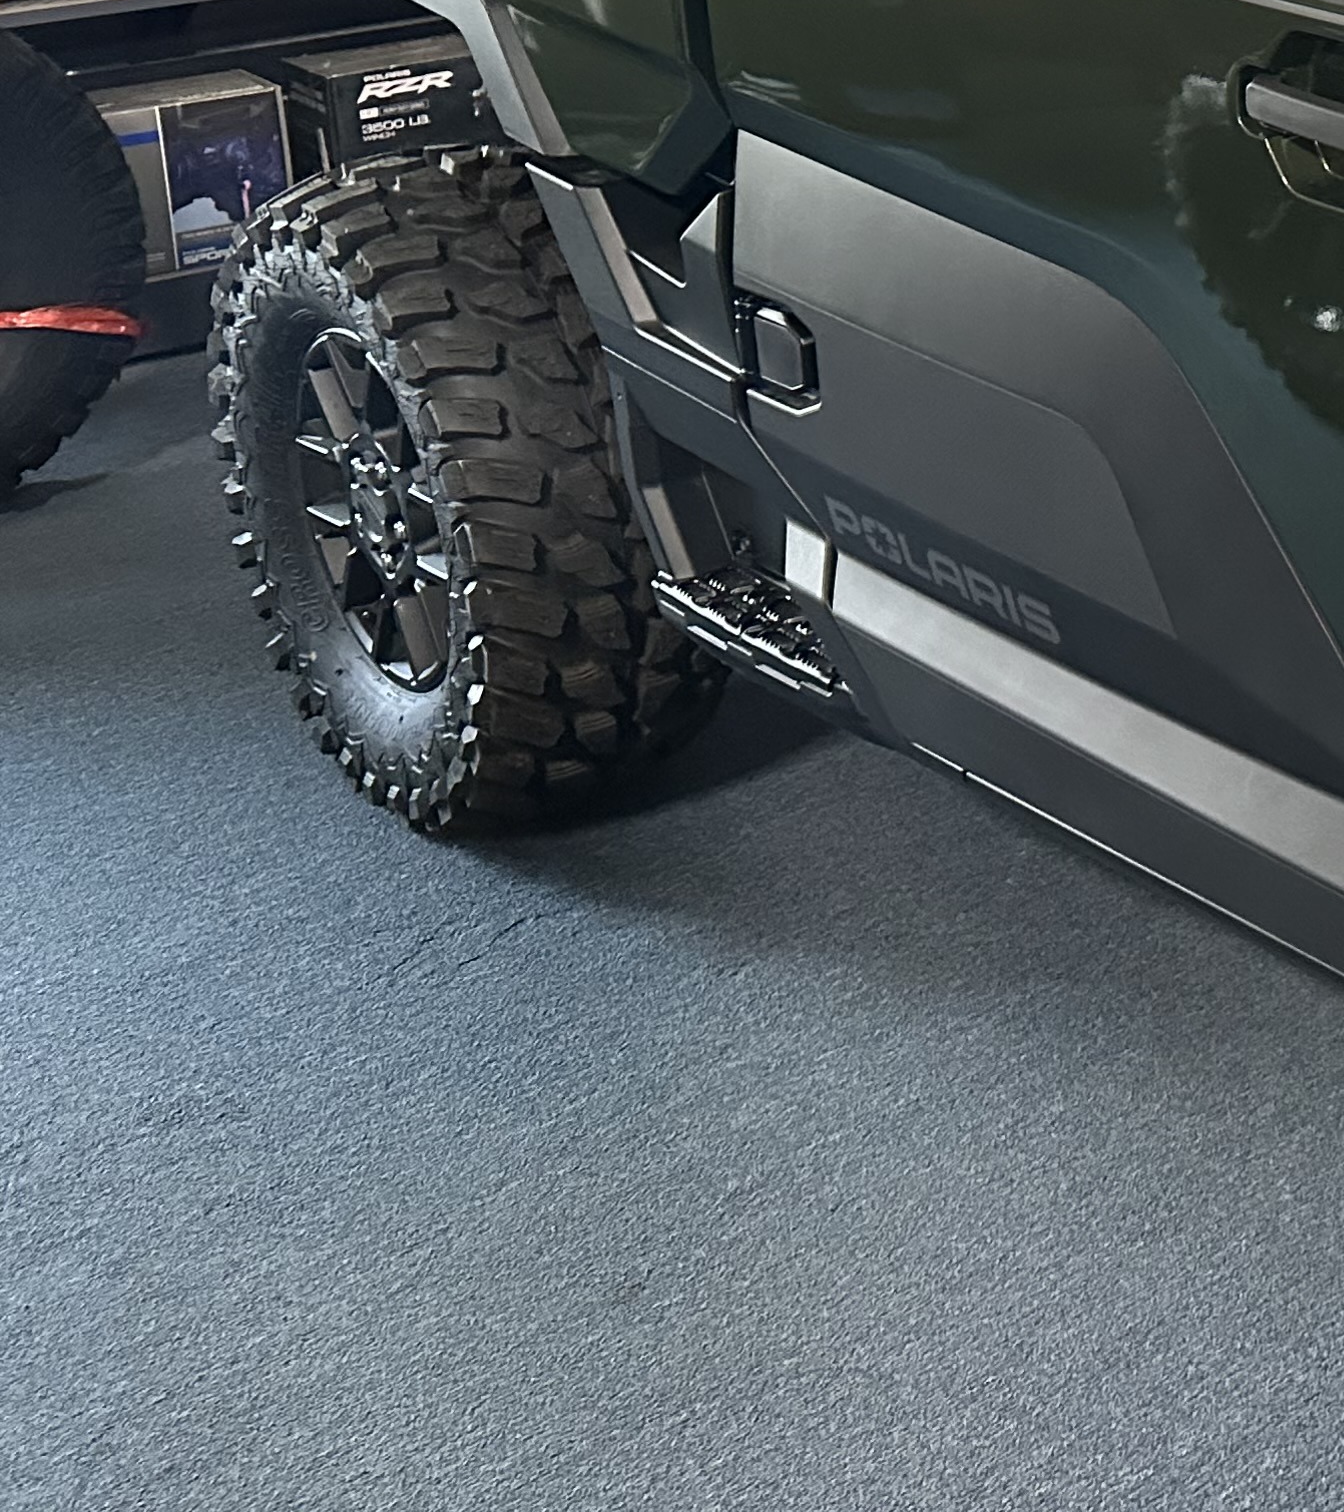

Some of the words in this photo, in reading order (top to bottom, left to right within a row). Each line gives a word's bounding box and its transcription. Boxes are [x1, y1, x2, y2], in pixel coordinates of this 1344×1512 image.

[357, 70, 454, 104] RZR
[361, 118, 404, 135] 3500
[824, 493, 1061, 645] POLARIS
